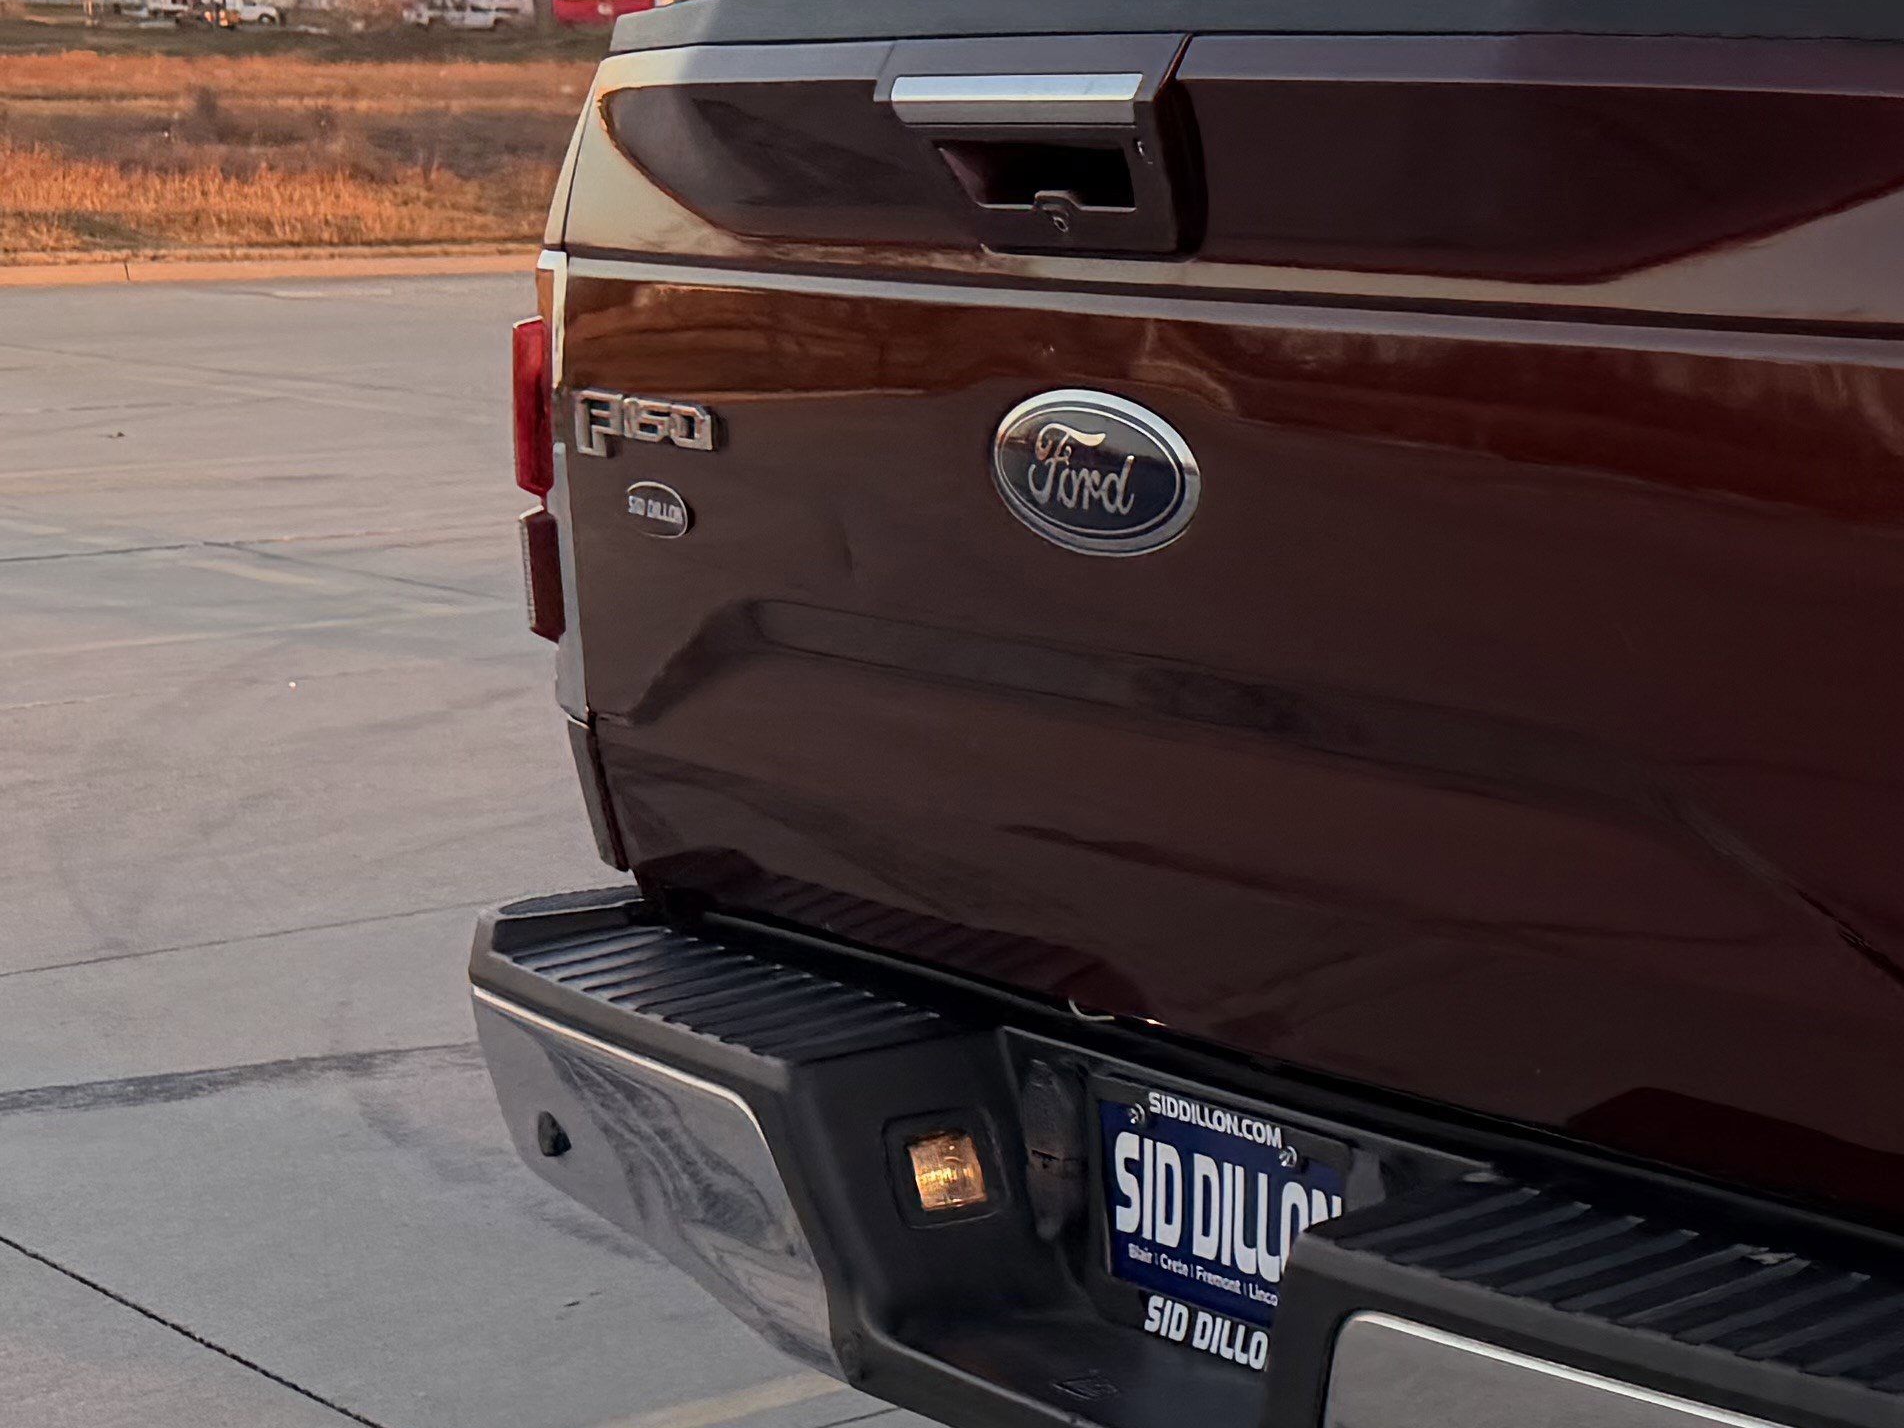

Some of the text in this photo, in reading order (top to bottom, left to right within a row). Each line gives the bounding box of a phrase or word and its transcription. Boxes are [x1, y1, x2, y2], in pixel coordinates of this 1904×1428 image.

[1027, 422, 1136, 516] Ford
[1148, 1091, 1283, 1149] SIDDILLON.COM
[1114, 1131, 1184, 1249] SID
[1143, 1293, 1269, 1372] SID DILLO
